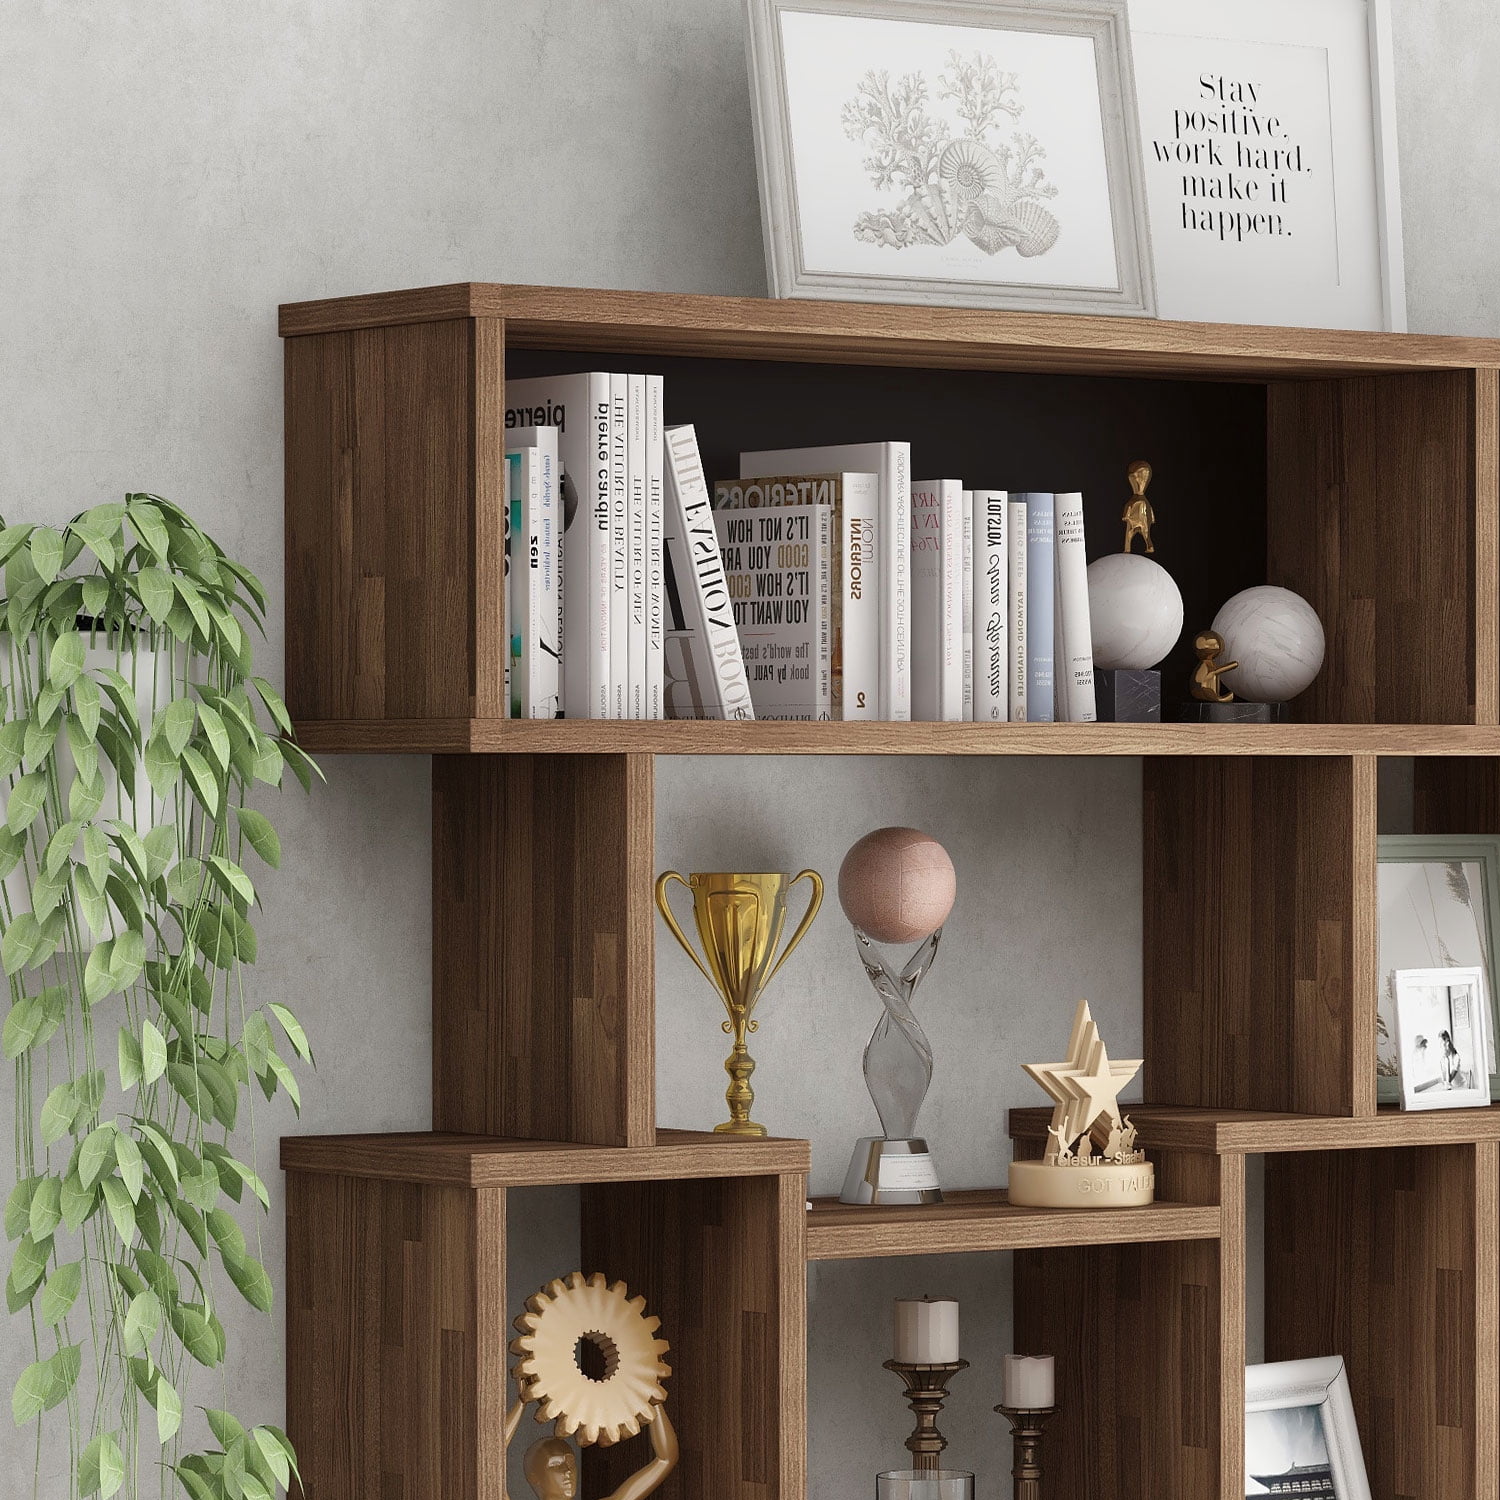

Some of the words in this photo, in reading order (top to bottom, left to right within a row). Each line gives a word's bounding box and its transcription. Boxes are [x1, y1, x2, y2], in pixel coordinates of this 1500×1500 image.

[1199, 73, 1262, 108] Stay
[1173, 104, 1290, 144] positive,
[1152, 138, 1224, 166] work
[1236, 141, 1313, 178] hard,
[1182, 172, 1259, 201] make
[1271, 173, 1291, 203] it
[1181, 202, 1292, 241] happen.
